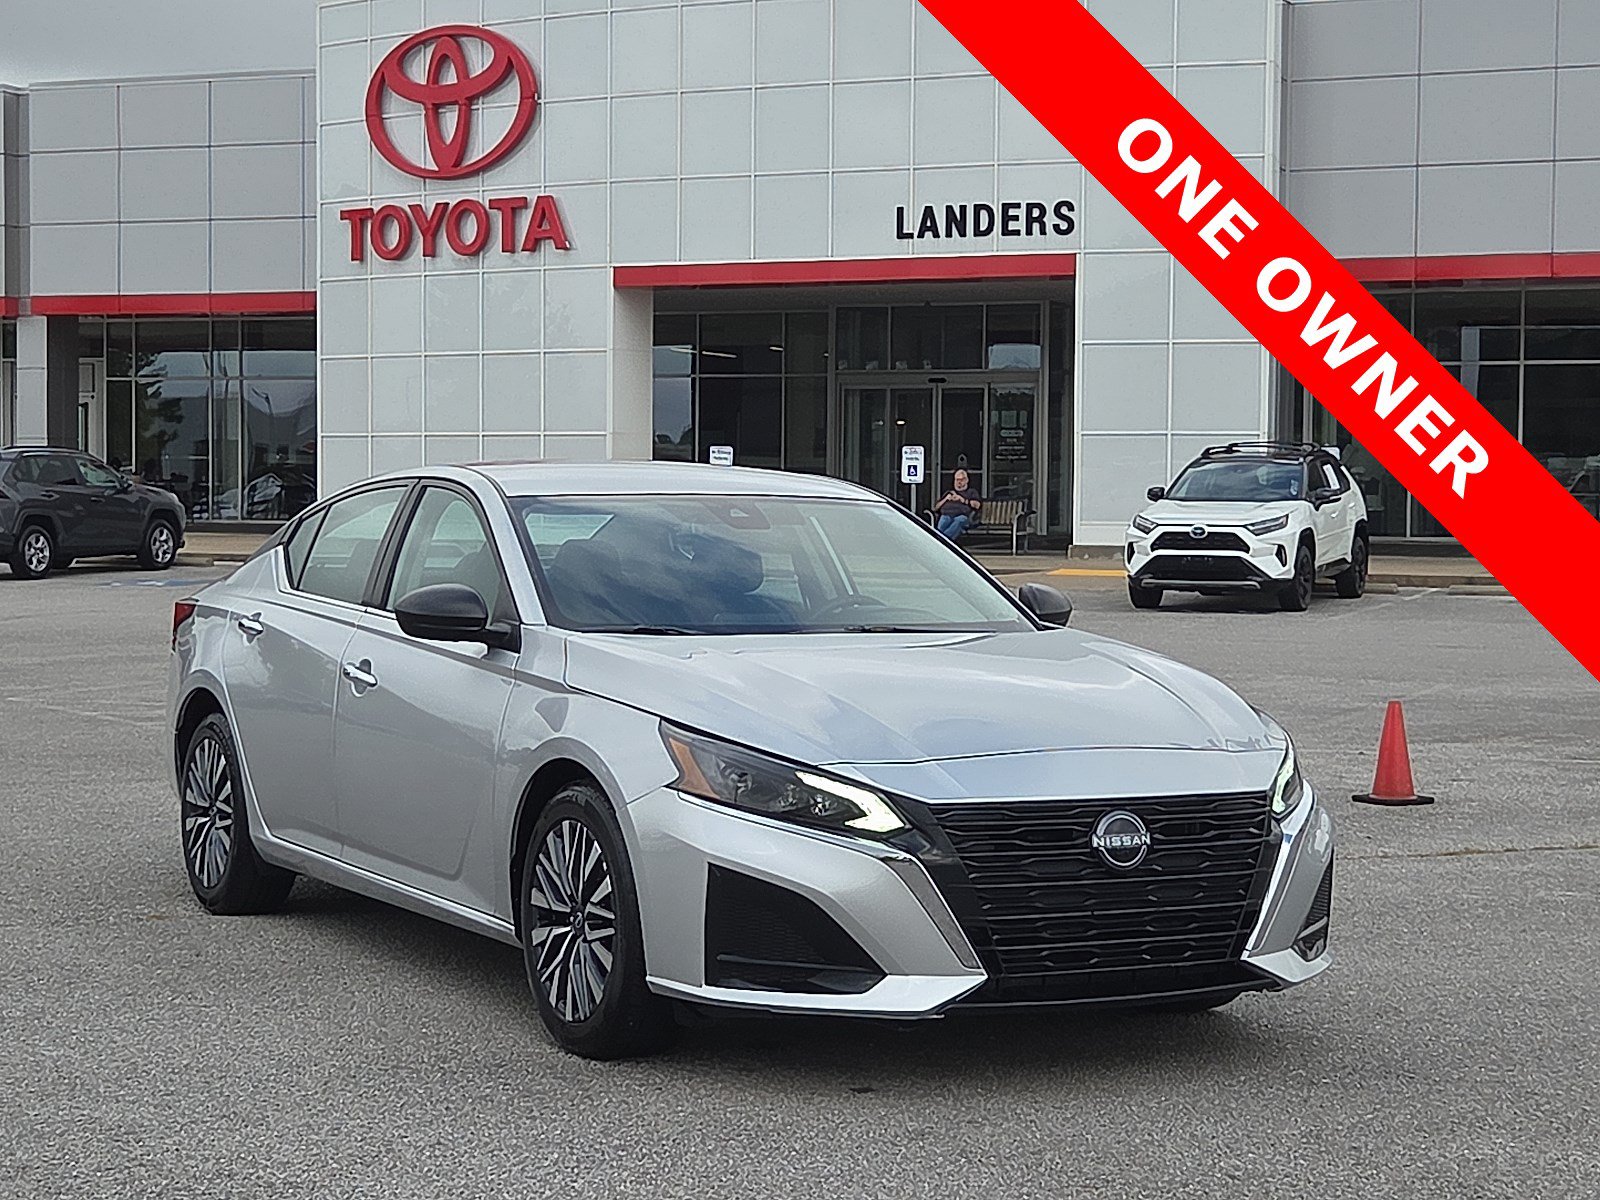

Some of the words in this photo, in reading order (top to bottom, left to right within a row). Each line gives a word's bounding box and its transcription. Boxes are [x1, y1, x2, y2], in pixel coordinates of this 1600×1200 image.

[340, 195, 571, 262] TOYOTA
[896, 200, 1075, 240] LANDERS
[1091, 832, 1151, 848] NISSAN
